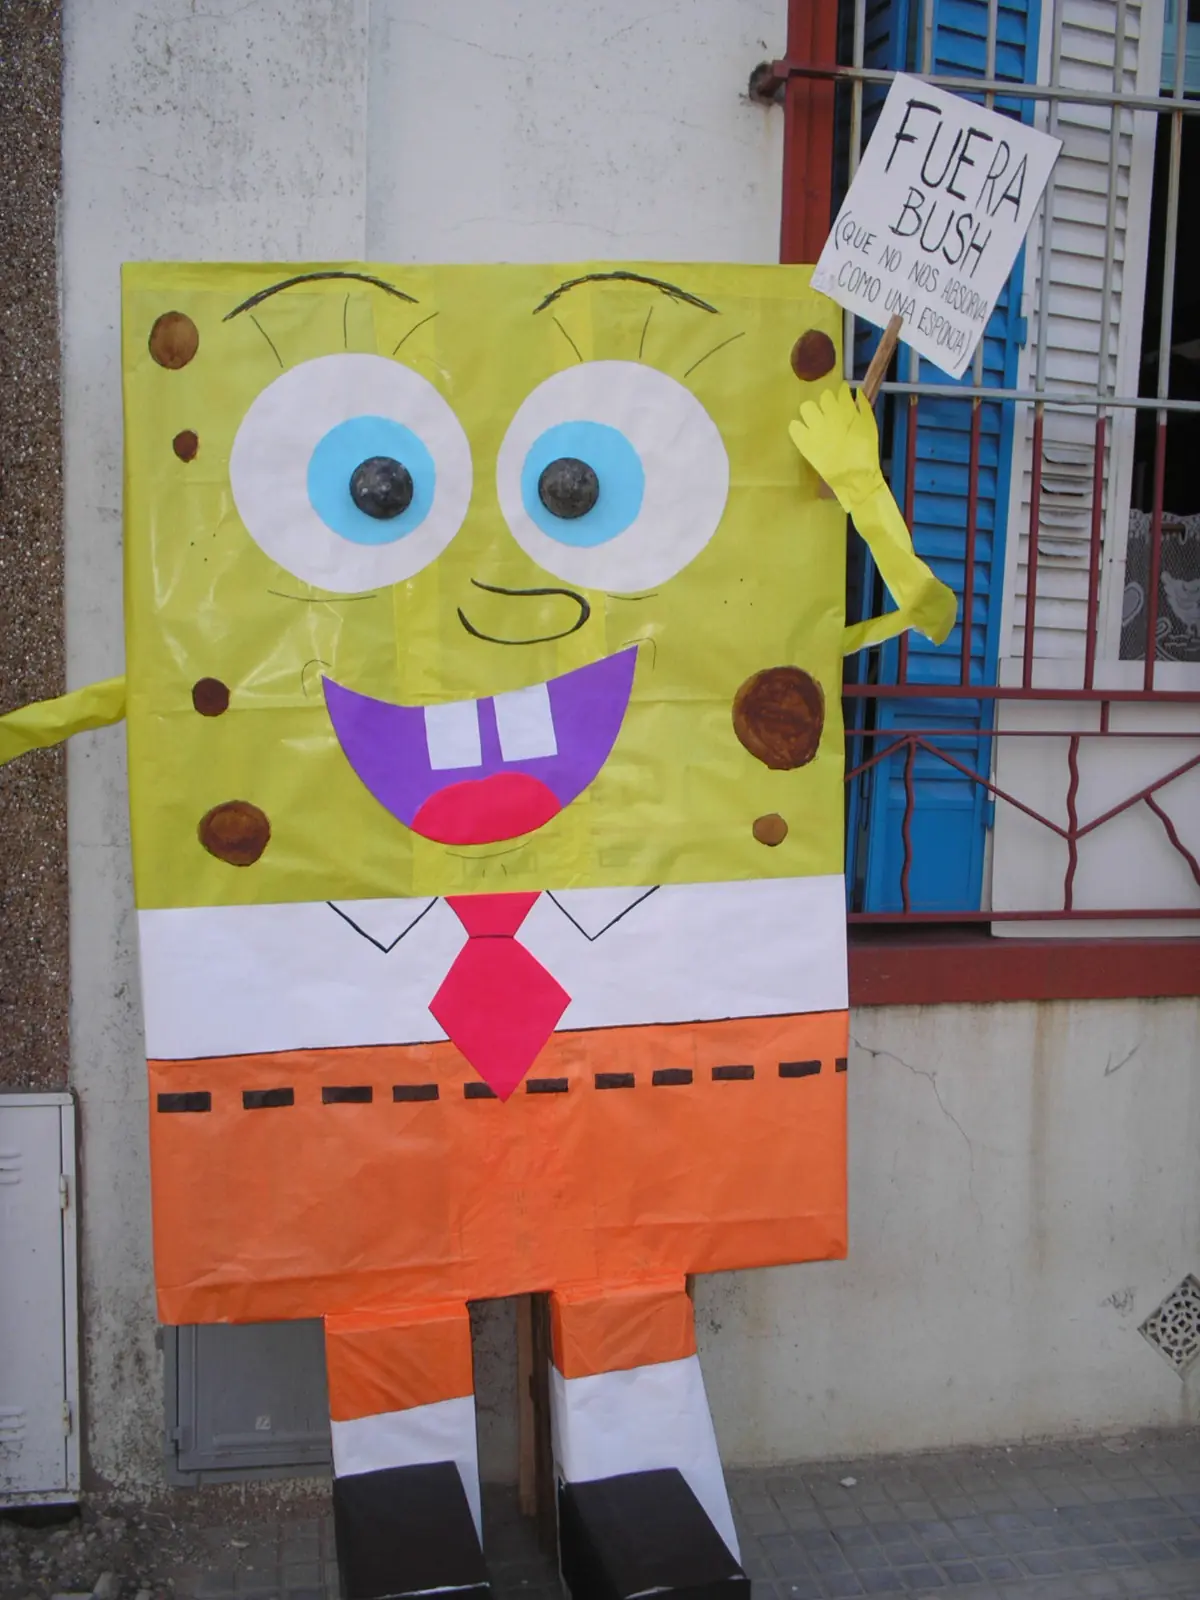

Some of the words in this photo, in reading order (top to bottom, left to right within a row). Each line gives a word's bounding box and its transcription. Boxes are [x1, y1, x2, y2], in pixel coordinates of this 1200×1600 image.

[885, 98, 1028, 223] FUERA
[835, 210, 877, 255] (QUE
[878, 245, 903, 273] NO
[908, 259, 940, 293] NOS
[888, 186, 993, 278] BUSH
[837, 260, 881, 303] COMO
[883, 288, 916, 325] UNA
